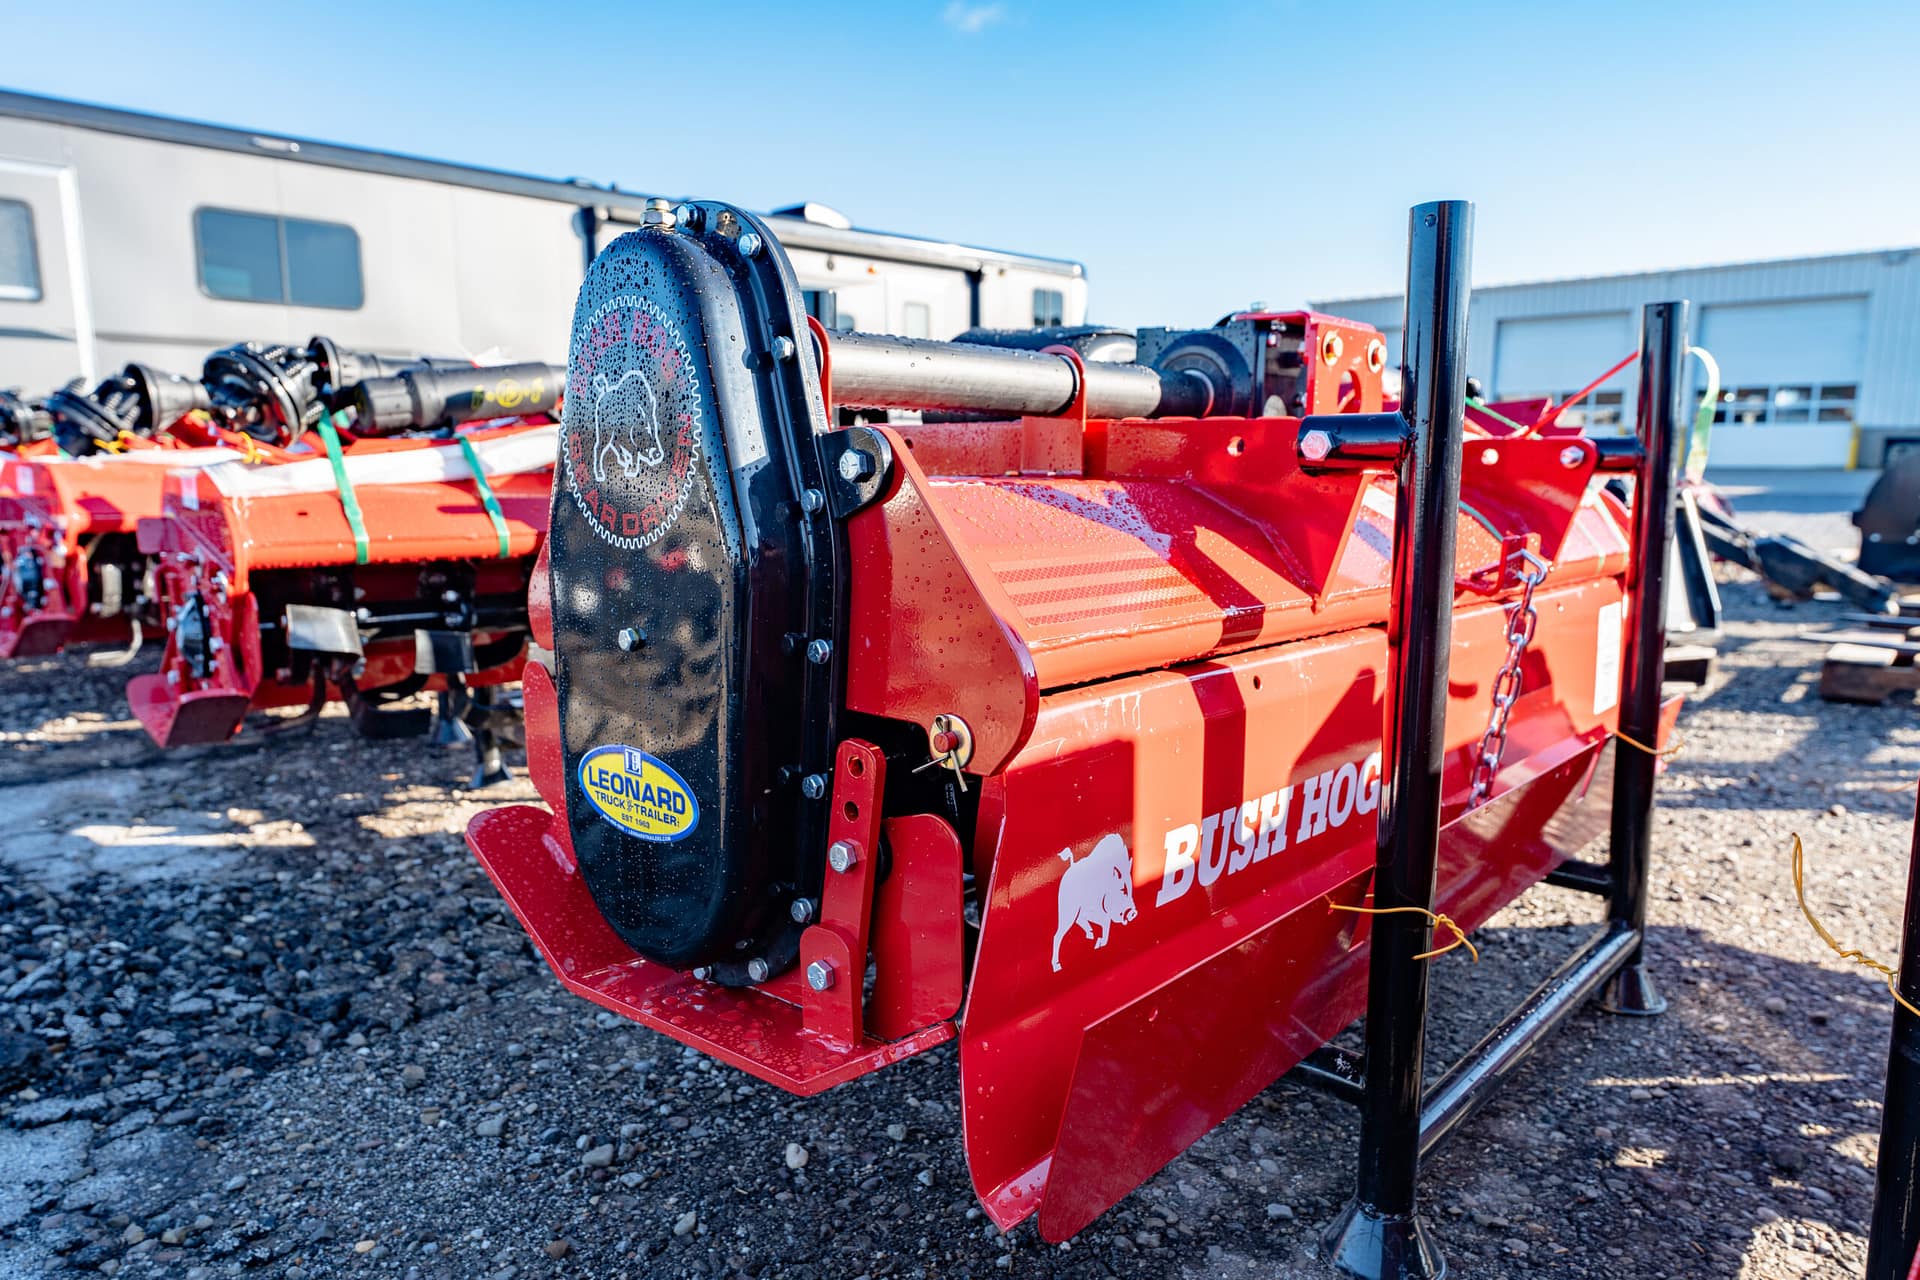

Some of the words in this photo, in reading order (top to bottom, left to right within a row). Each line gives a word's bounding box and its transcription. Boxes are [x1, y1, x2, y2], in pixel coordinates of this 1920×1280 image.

[571, 311, 623, 398] BUSH
[630, 309, 681, 382] HOG
[569, 432, 617, 530] GEAR
[622, 414, 692, 535] DRIVEN
[588, 765, 685, 814] LEONARD
[595, 790, 626, 810] TRUCK
[634, 803, 677, 826] TRAILER
[1157, 785, 1294, 907] BUSH
[1295, 752, 1381, 844] HOG
